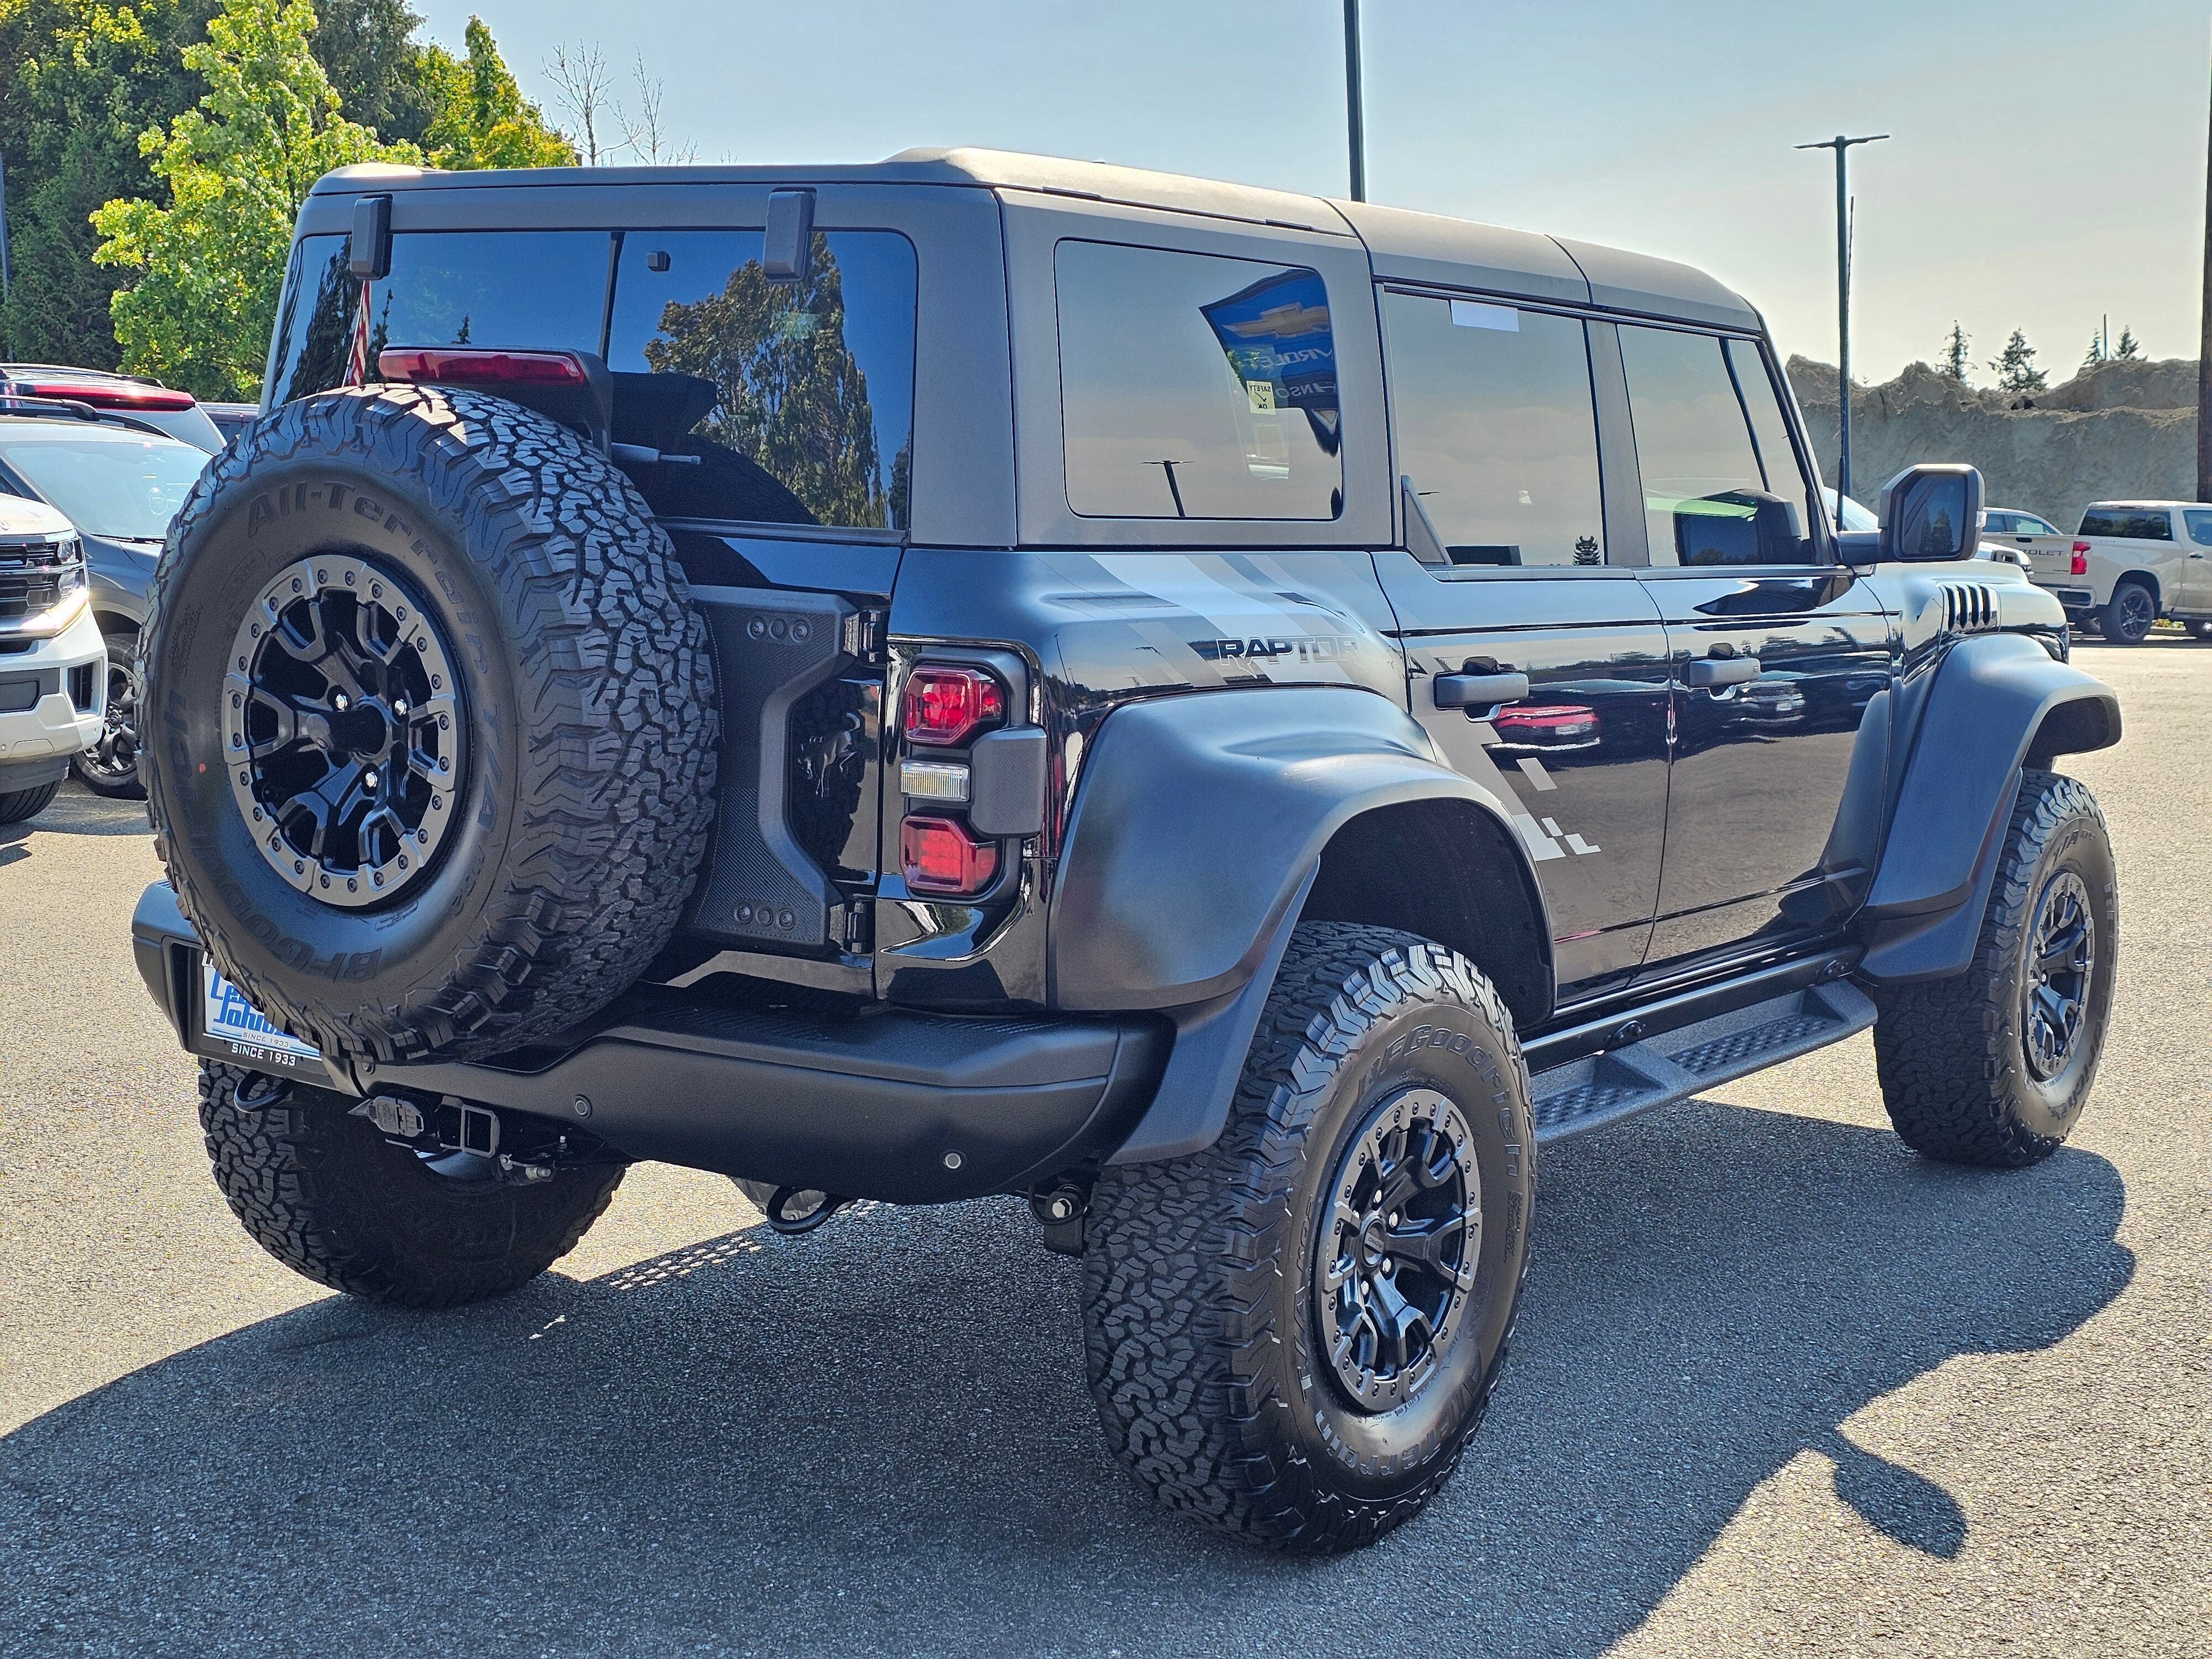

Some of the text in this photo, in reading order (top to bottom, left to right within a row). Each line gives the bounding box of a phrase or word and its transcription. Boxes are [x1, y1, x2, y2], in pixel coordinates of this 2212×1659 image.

[1216, 634, 1369, 679] RAPTOR
[231, 1042, 296, 1067] SINCE 1933
[242, 1032, 289, 1048] SINCE 1933
[1358, 1024, 1522, 1177] BFGoodrich
[1315, 1348, 1483, 1477] All-Terrain
